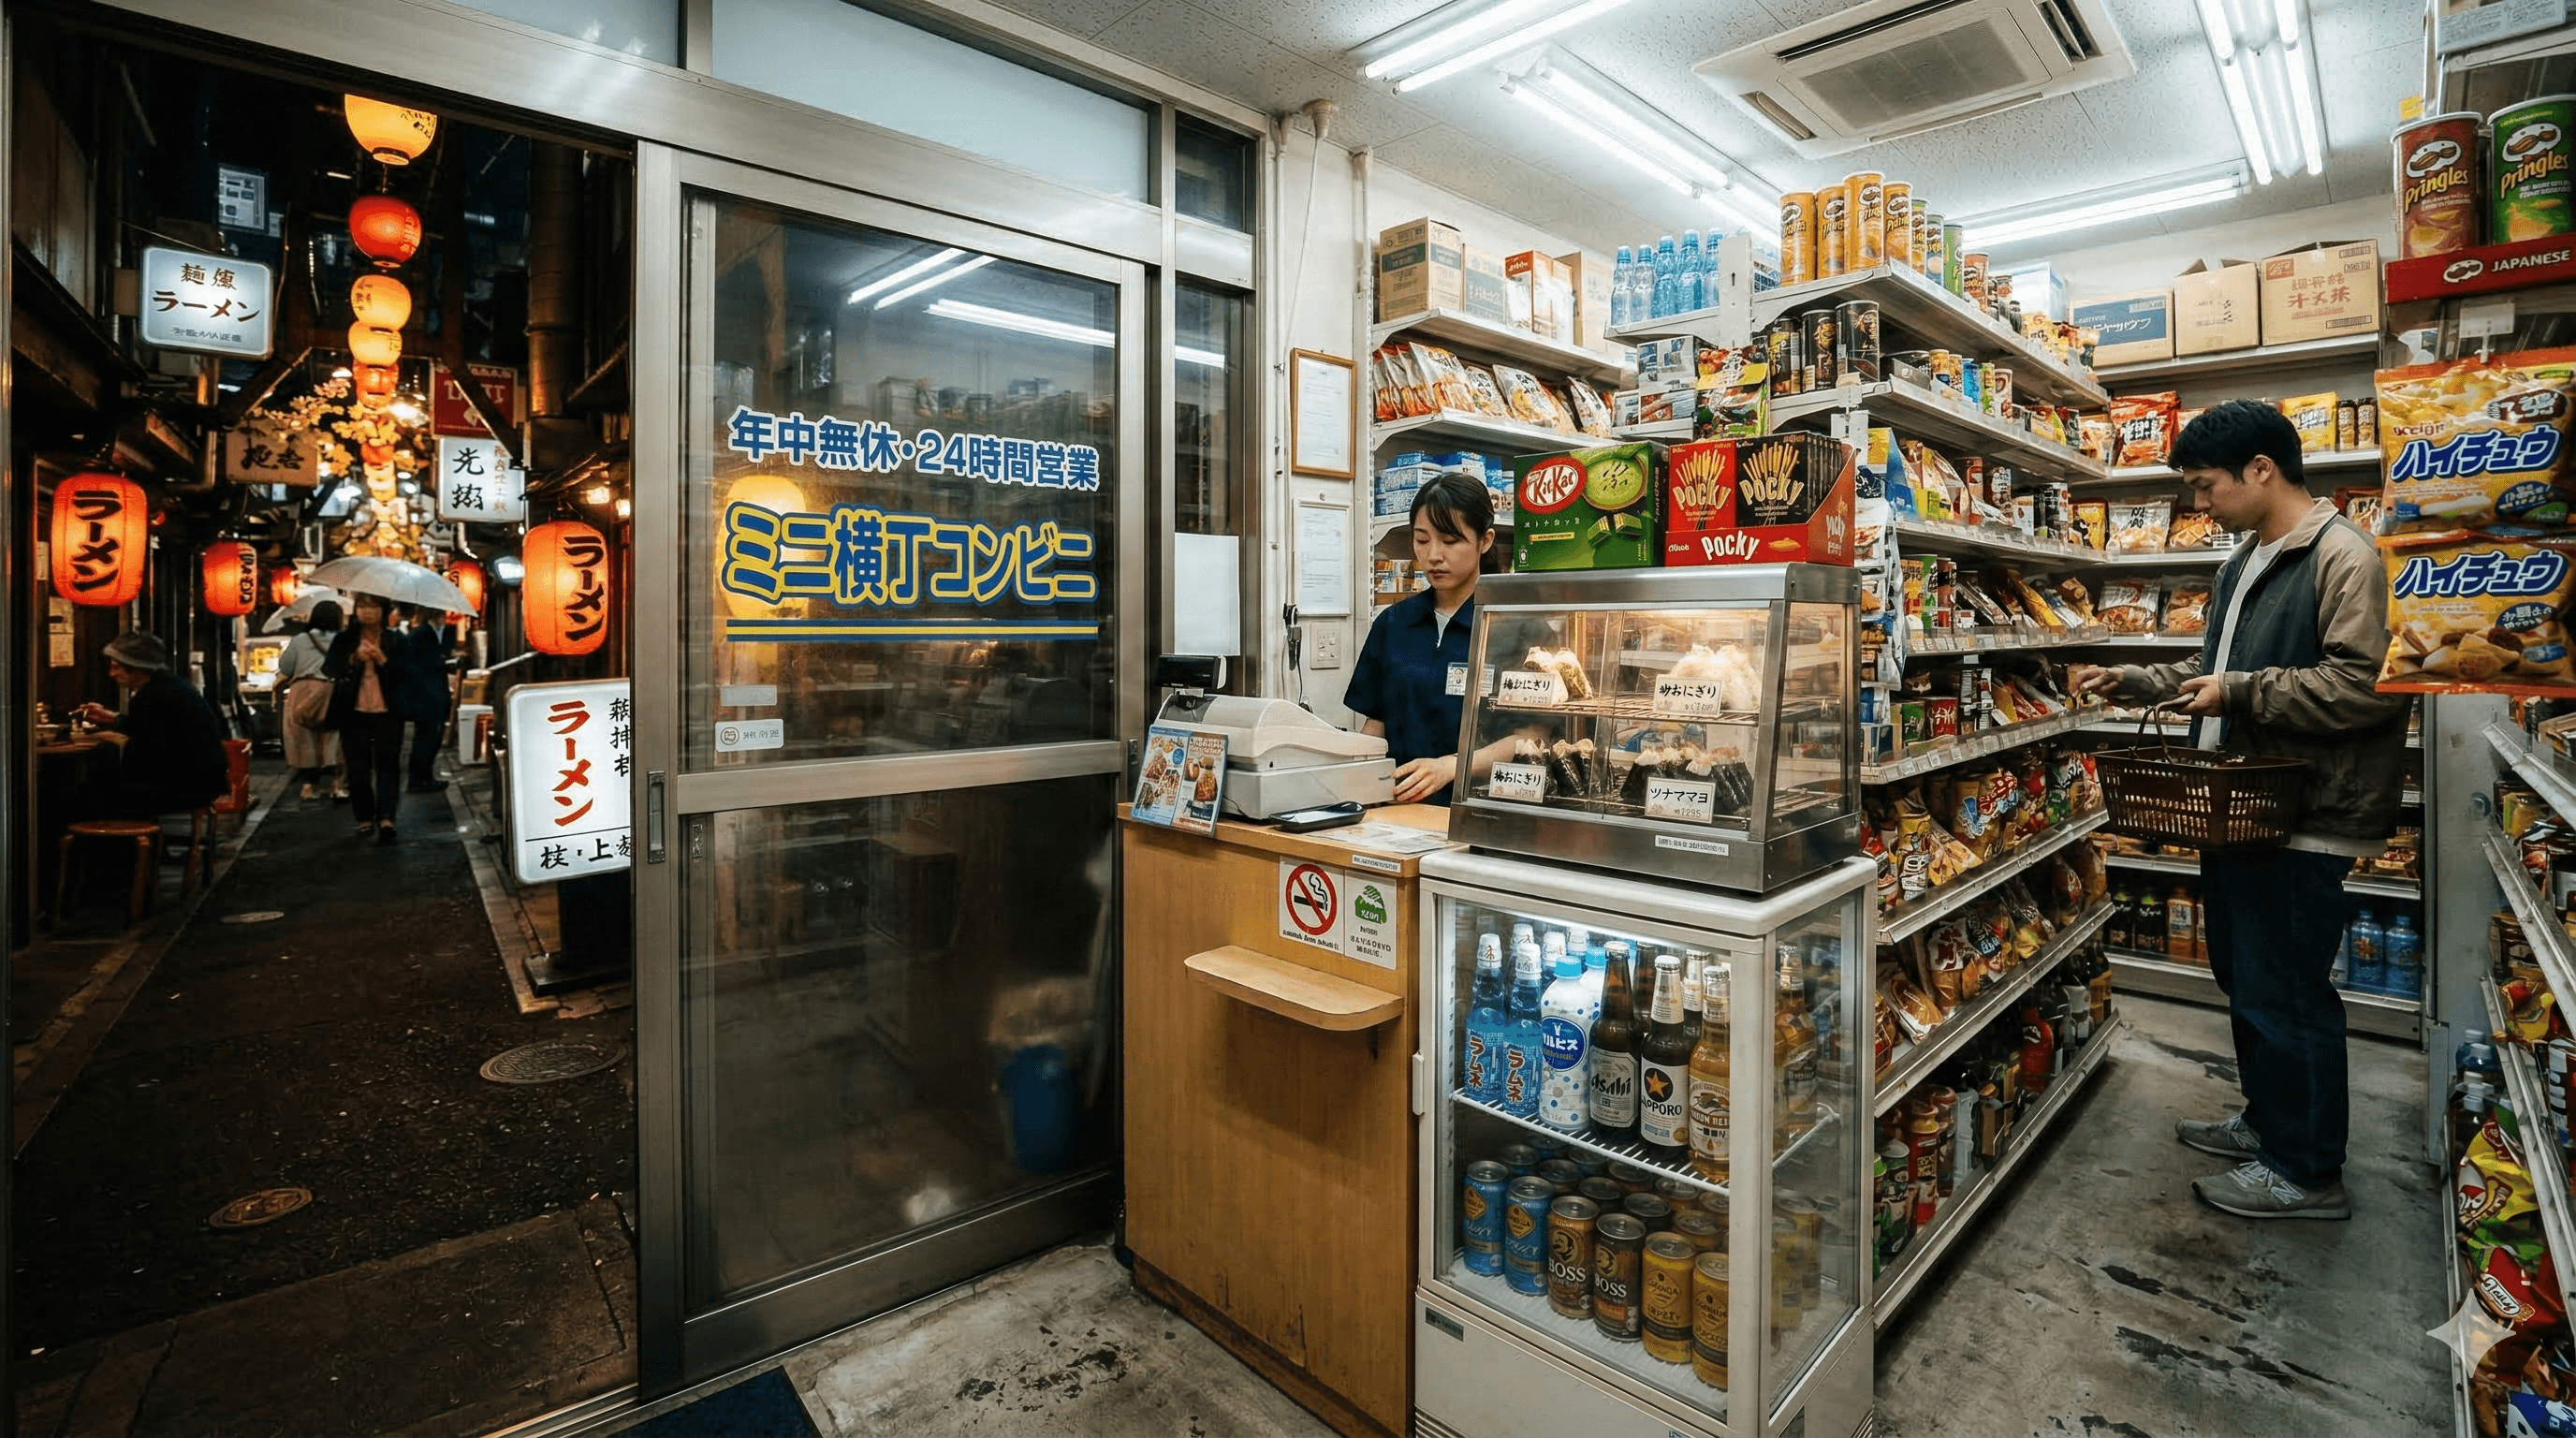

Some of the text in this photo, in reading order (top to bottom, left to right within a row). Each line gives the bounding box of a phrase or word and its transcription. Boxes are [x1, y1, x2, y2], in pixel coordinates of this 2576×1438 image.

[2405, 166, 2468, 214] Pringles
[2501, 151, 2569, 199] Pringles
[2491, 250, 2571, 272] JAPANESE
[152, 289, 261, 322] ラーメン
[727, 404, 1100, 492] 年中無休・24時間営業
[2390, 422, 2565, 484] ハイチュウ
[71, 489, 124, 593] ラーメン
[722, 501, 1100, 609] ミニ横丁コンビニ
[564, 536, 605, 641] ラーメン
[2393, 548, 2569, 600] ハイチュウ
[548, 700, 593, 827] ラーメン
[1650, 787, 1708, 803] ツナママヨ
[1469, 1034, 1486, 1090] ラムネ
[1507, 1048, 1526, 1104] ラムネ
[1548, 1257, 1586, 1282] BOSS
[1594, 1273, 1627, 1298] BOSS
